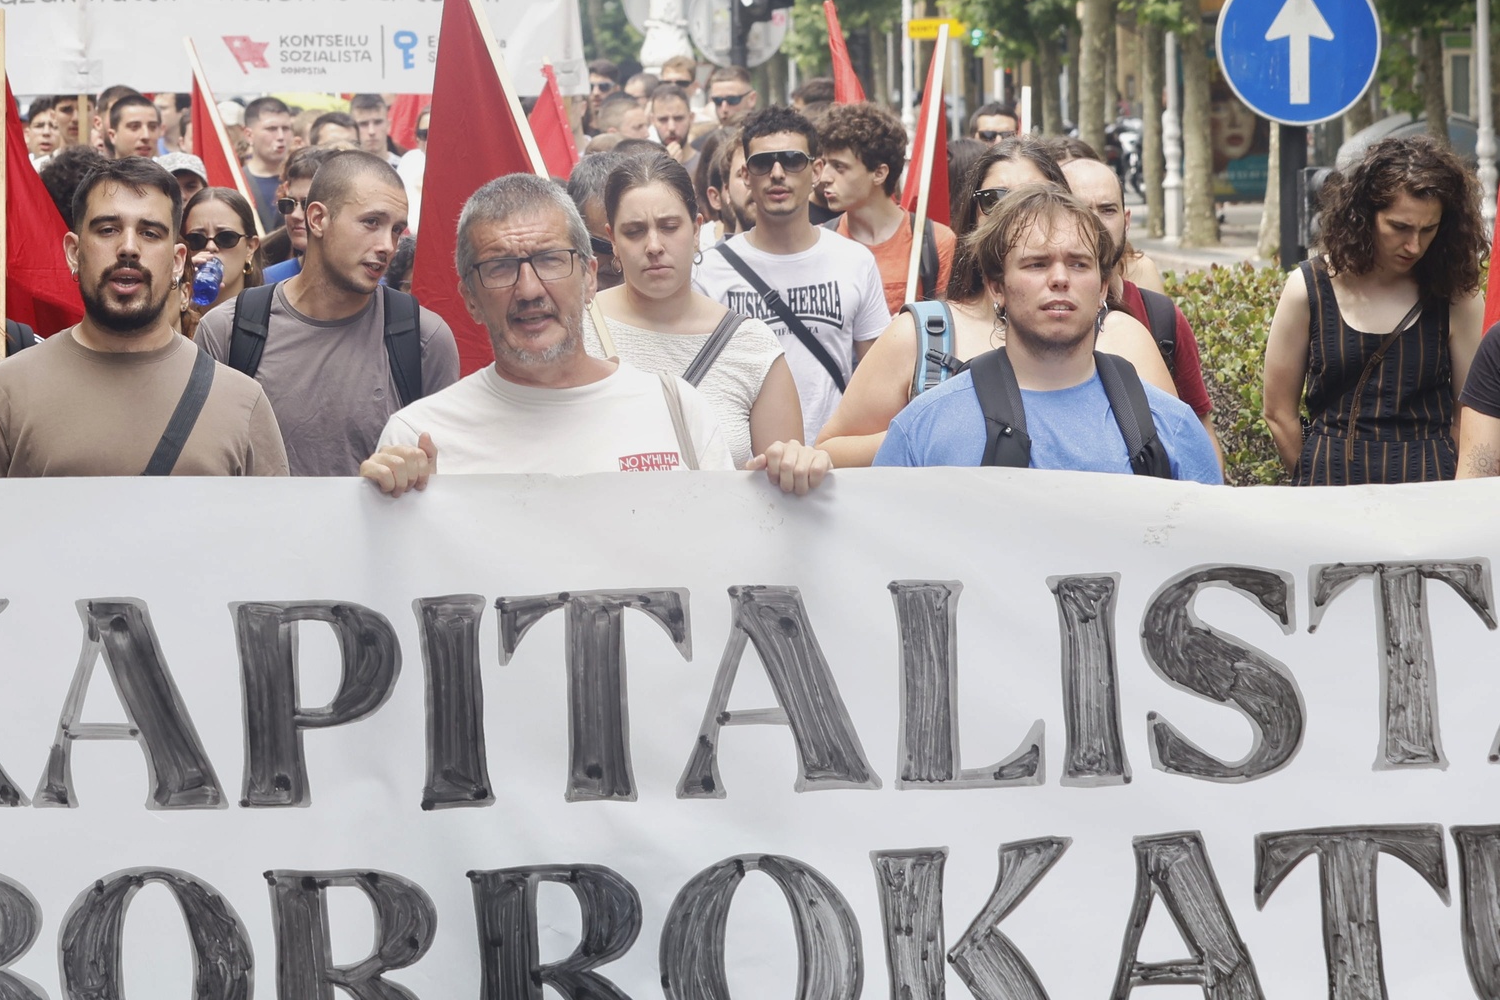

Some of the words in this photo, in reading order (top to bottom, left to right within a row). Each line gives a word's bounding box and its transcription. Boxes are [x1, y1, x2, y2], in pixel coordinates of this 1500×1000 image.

[279, 34, 369, 48] KONTSEILU
[279, 49, 372, 64] SOZIALISTA
[787, 280, 842, 322] HERRIA
[619, 456, 639, 469] NO
[663, 453, 679, 465] HA
